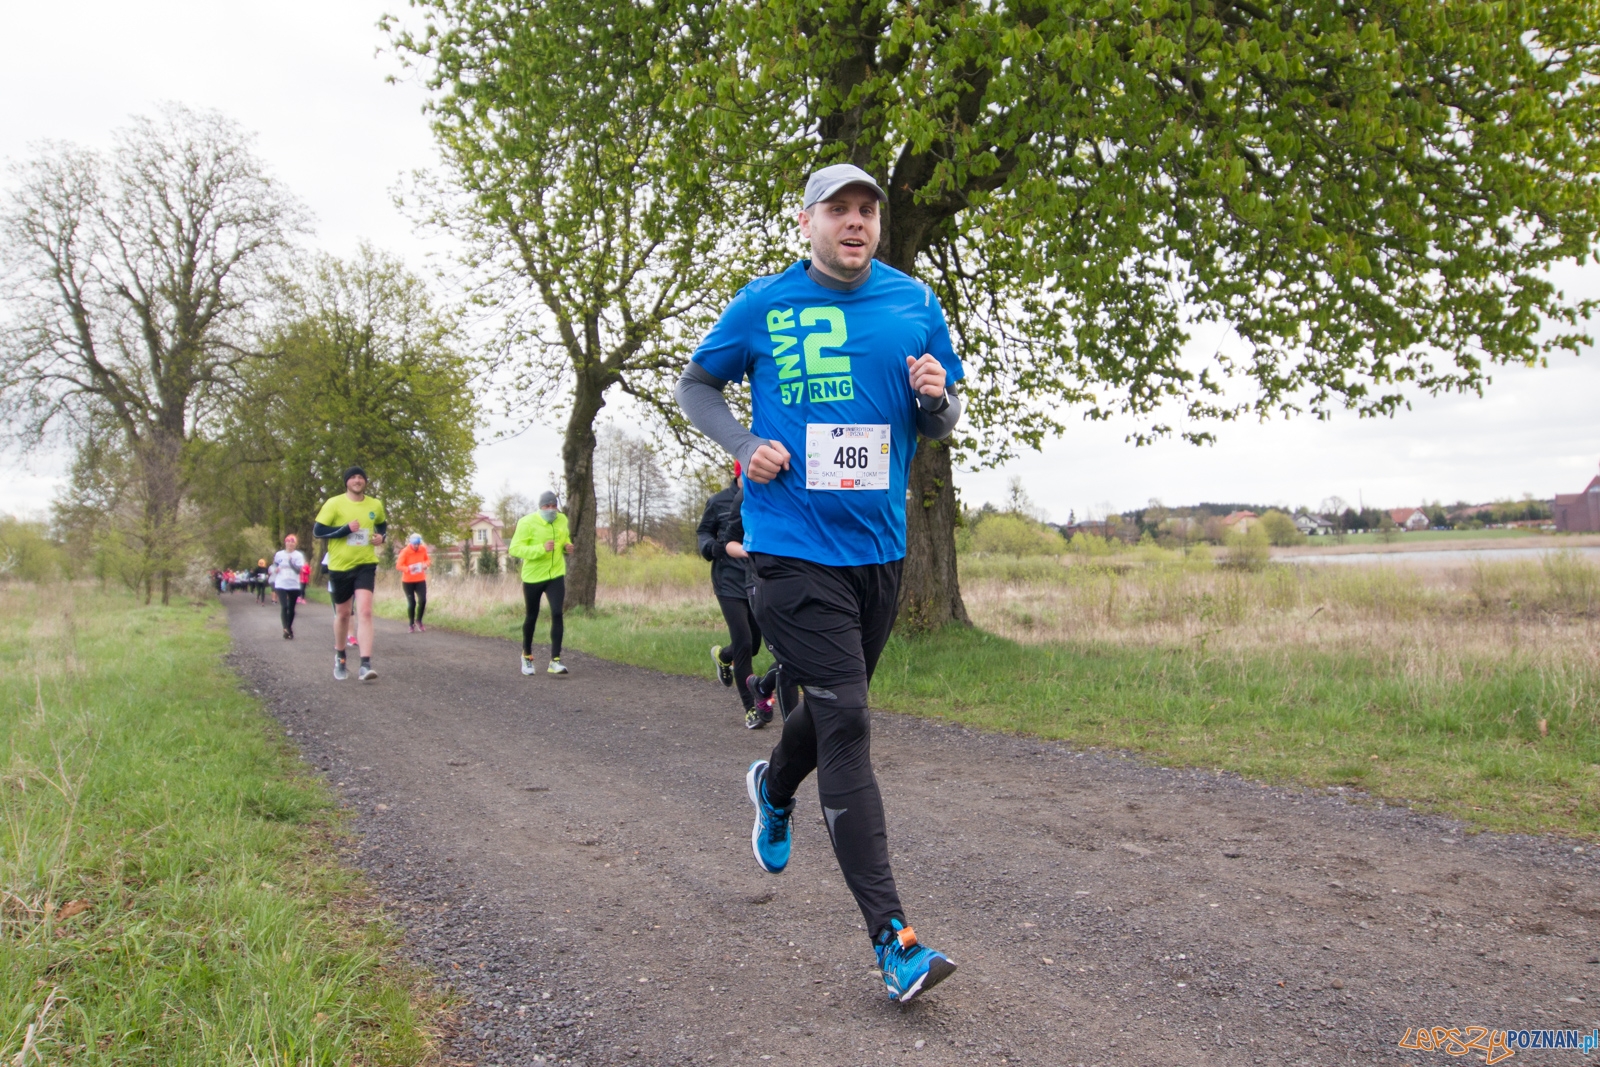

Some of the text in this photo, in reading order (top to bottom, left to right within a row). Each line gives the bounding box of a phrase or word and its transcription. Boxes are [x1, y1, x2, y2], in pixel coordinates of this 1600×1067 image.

[766, 307, 802, 380] NVR
[799, 306, 851, 375] 2
[780, 380, 852, 406] 57 RNG
[834, 446, 868, 469] 486
